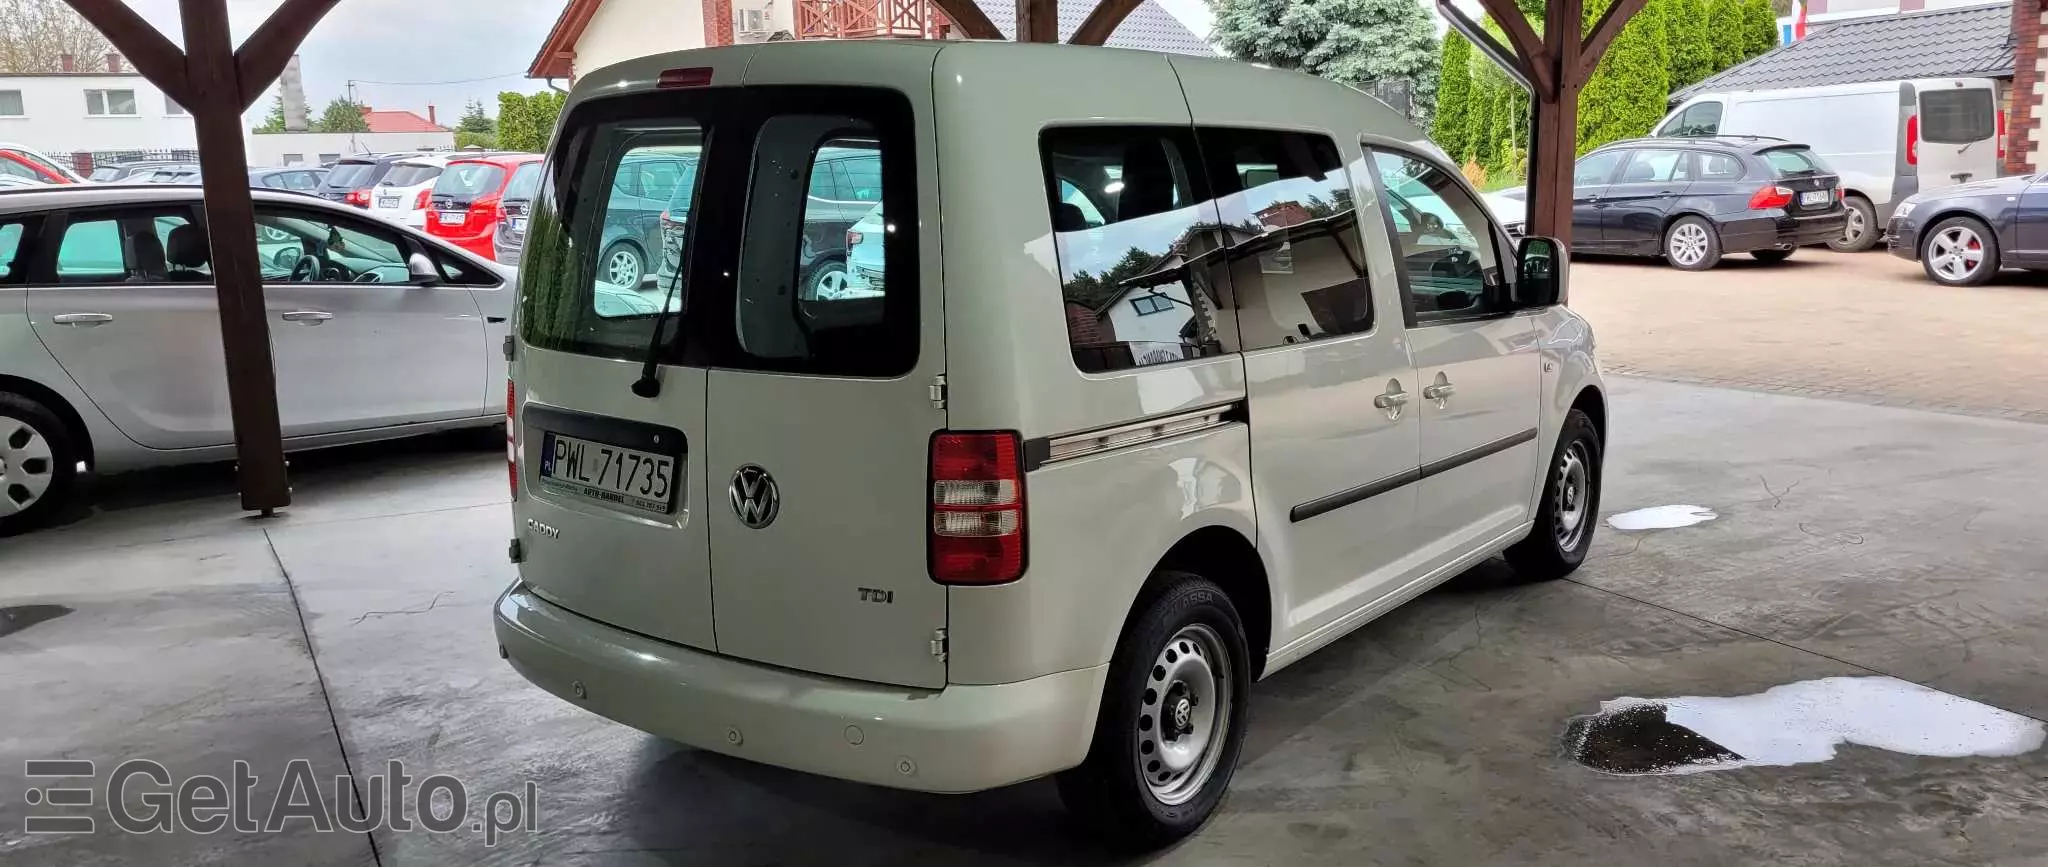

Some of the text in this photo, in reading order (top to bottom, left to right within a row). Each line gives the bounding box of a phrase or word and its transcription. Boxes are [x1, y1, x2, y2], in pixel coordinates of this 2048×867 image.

[552, 439, 670, 498] PWL 71735
[527, 518, 560, 540] CADDY
[858, 587, 894, 604] TDI
